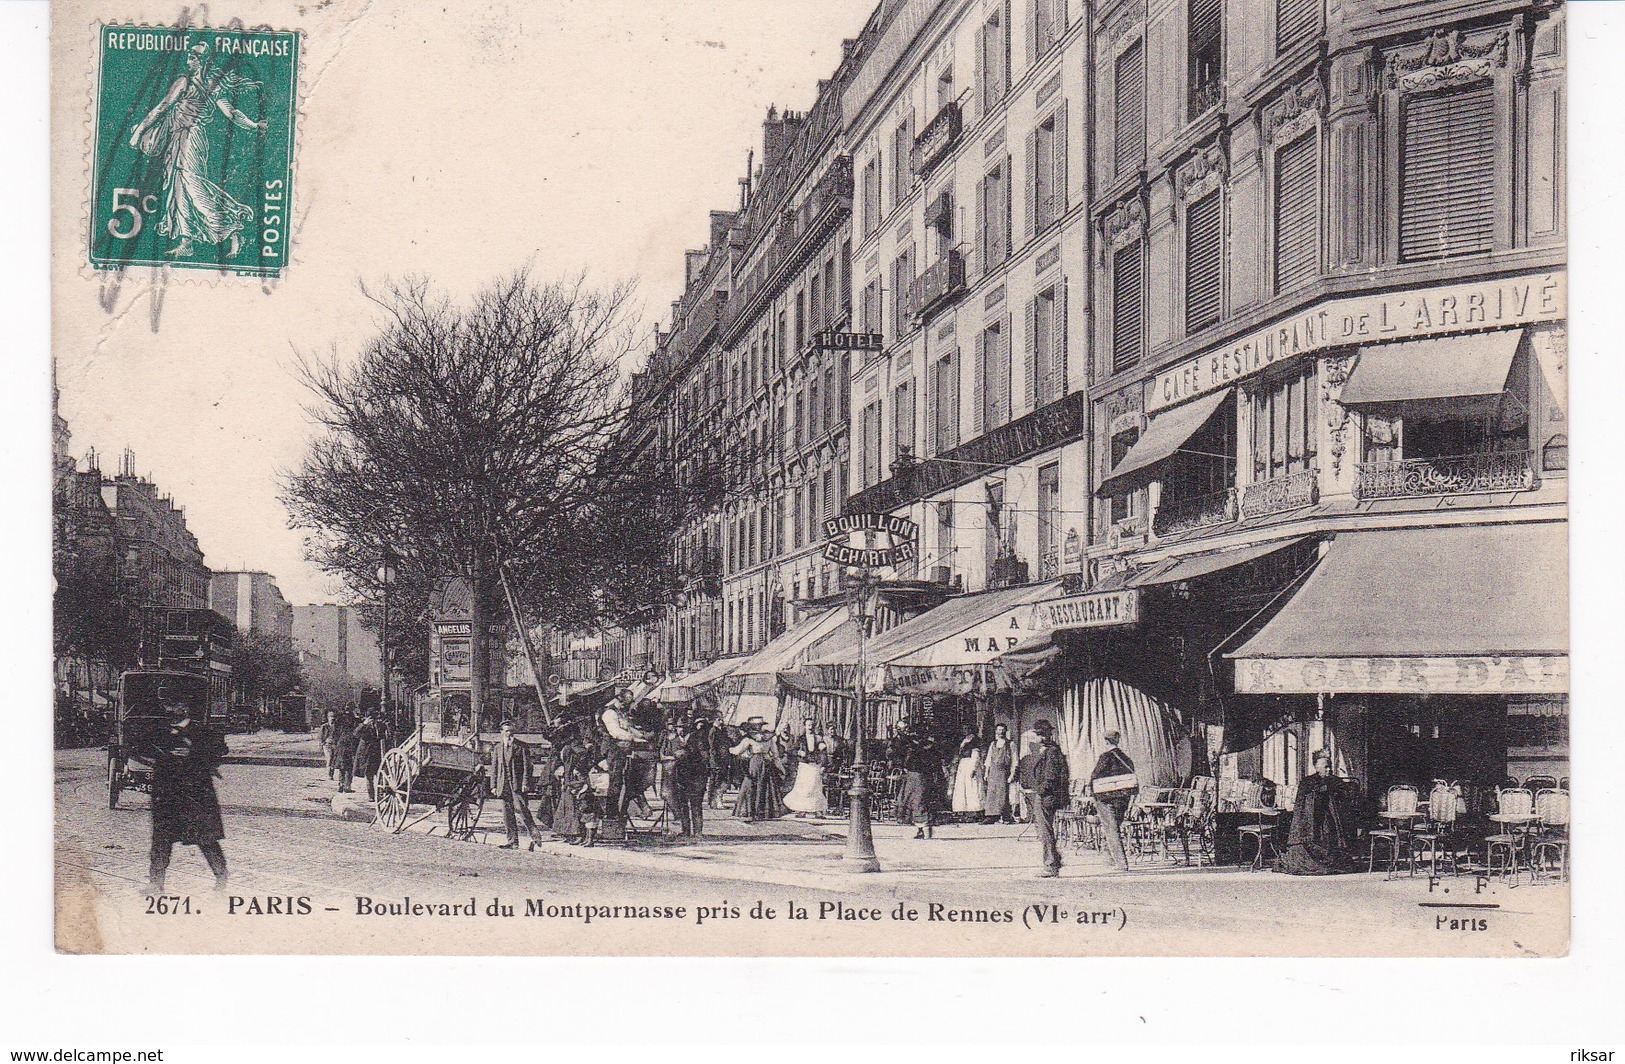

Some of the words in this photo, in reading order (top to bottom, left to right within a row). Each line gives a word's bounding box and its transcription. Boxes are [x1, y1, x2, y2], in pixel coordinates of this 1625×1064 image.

[107, 31, 191, 51] REPUBLIQUE
[214, 36, 290, 57] FRANÇAISE
[261, 178, 283, 258] POSTES
[821, 333, 876, 348] HOTEL
[1211, 309, 1328, 386] RESTAURANT
[1340, 313, 1370, 337] DE
[826, 513, 912, 536] BOUILLON
[825, 542, 913, 566] E.CHARTER
[1050, 596, 1120, 626] RESTAURANT
[438, 624, 471, 634] ANGELUS
